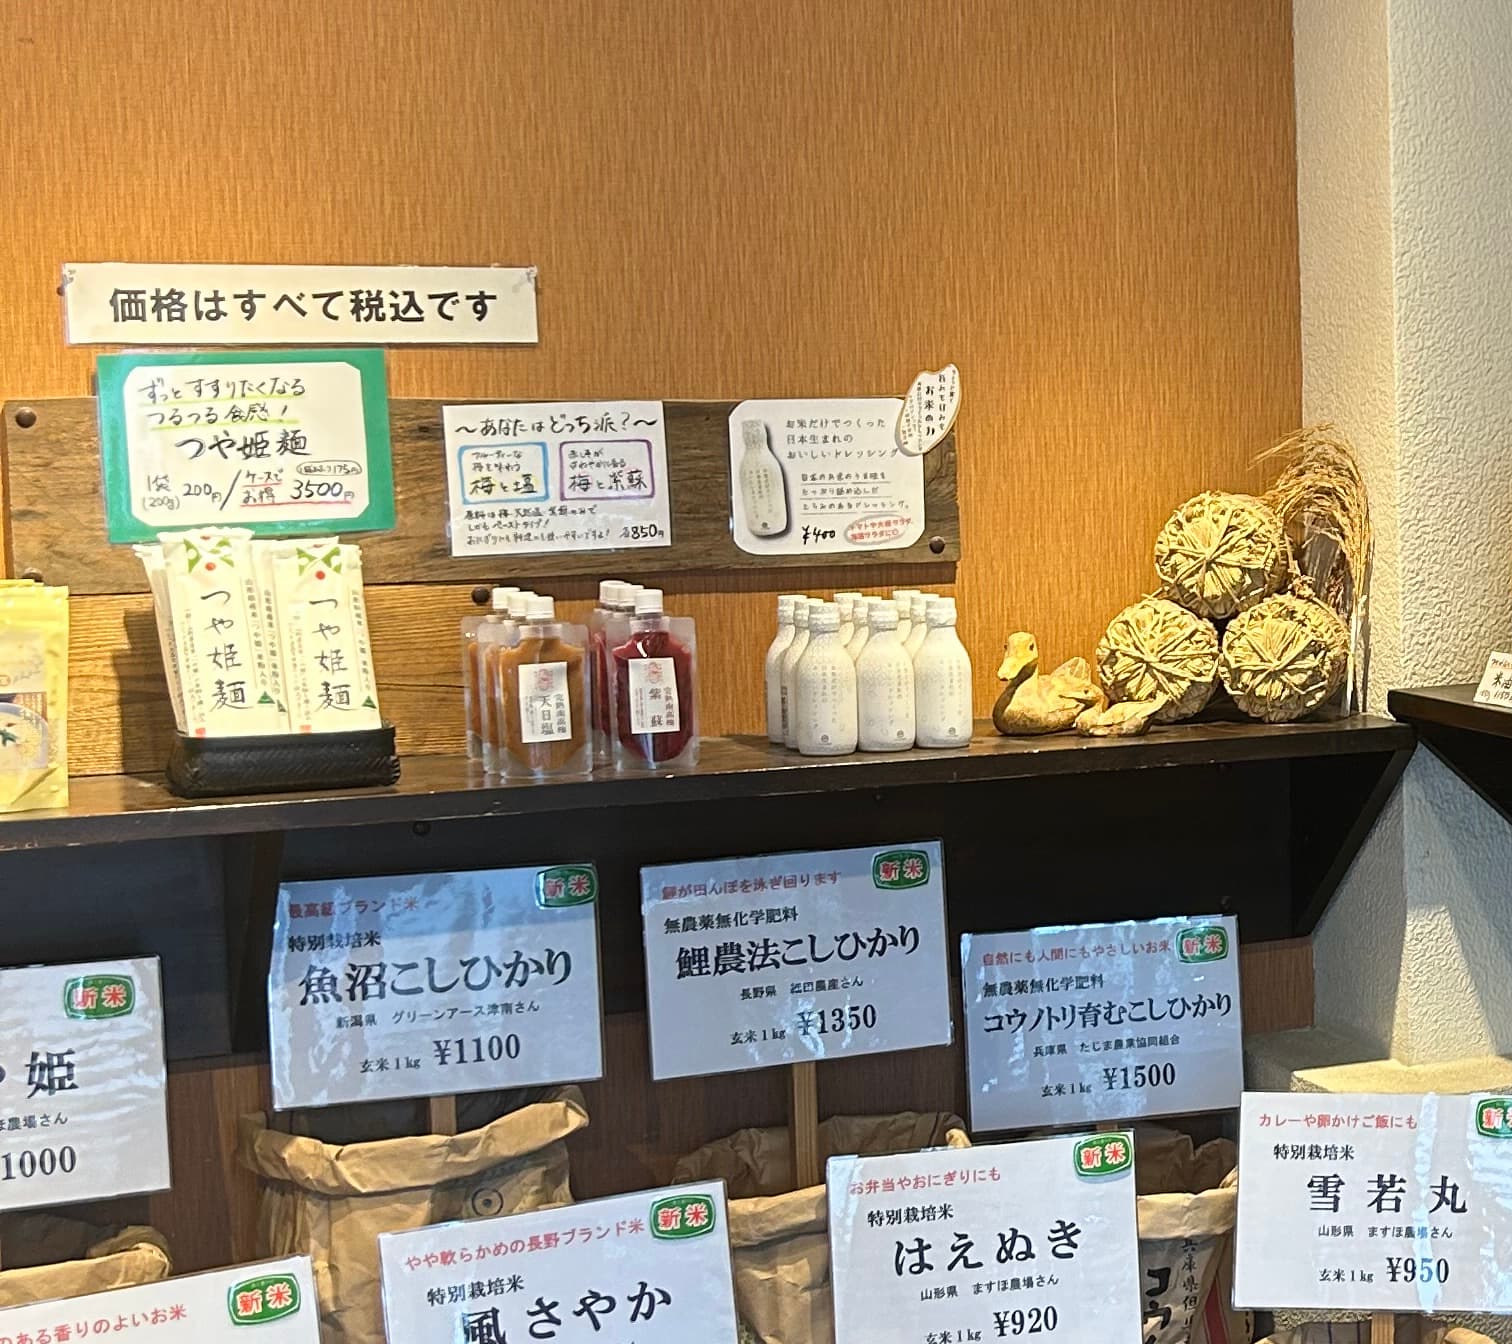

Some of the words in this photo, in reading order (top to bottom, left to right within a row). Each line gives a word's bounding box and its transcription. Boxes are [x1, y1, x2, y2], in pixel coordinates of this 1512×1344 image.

[110, 286, 498, 324] 価格はすべて税込です
[785, 418, 886, 429] お米だけでつくった
[175, 429, 312, 460] つや姫麺
[786, 433, 853, 445] 日本生まれの
[470, 473, 538, 495] 梅と塩
[568, 470, 648, 492] 梅と紫蘇
[242, 487, 276, 505] お得
[200, 590, 253, 712] つや姫麺
[308, 598, 360, 714] つや姫麺
[540, 695, 555, 735] 天日塩
[880, 858, 924, 882] 新米
[545, 874, 591, 899] 新米
[662, 871, 841, 900] 鯉が田んぼを泳ぎ回ります
[664, 906, 799, 934] 無農薬無化学肥料
[288, 930, 381, 954] 特別栽培米
[676, 925, 920, 980] 鯉農法こしひかり
[983, 940, 1171, 966] 自然にも人間にもやさしいお米
[1182, 937, 1223, 955] 新米
[298, 948, 572, 1006] 魚沼こしひかり
[983, 974, 1104, 998] 無農薬無化学肥料
[73, 984, 127, 1010] 新米
[741, 984, 776, 1000] 長野県
[336, 1014, 377, 1030] 新潟県
[392, 1001, 540, 1025] グリーンアース津南さん
[797, 1004, 877, 1036] ¥1350
[983, 993, 1232, 1034] コウノトリ育むこしひかり
[433, 1033, 520, 1066] ¥1100
[1033, 1044, 1067, 1058] 兵庫県
[1080, 1035, 1180, 1053] たじま農業協同組合
[0, 1049, 79, 1099] 姫
[1103, 1063, 1176, 1091] ¥1500
[1259, 1114, 1418, 1129] カレーや卵かけご飯にも
[1081, 1143, 1126, 1168] 新米
[1273, 1143, 1355, 1161] 特別栽培米
[850, 1168, 1000, 1195] お弁当やおにぎりにも
[1307, 1173, 1469, 1215] 雪若丸
[657, 1203, 709, 1230] 新米
[867, 1203, 954, 1227] 特別栽培米
[406, 1219, 645, 1271] やや軟らかめの長野ブランド米
[1318, 1225, 1354, 1238] 山形県
[1367, 1225, 1453, 1239] ますほ農場さん
[895, 1220, 1082, 1277] はえぬき
[1386, 1257, 1449, 1284] ¥950
[236, 1282, 293, 1316] 新米
[427, 1273, 525, 1306] 特別栽培米
[921, 1285, 958, 1302] 山形県
[973, 1274, 1059, 1294] ますほ農場さん
[993, 1306, 1059, 1337] ¥920
